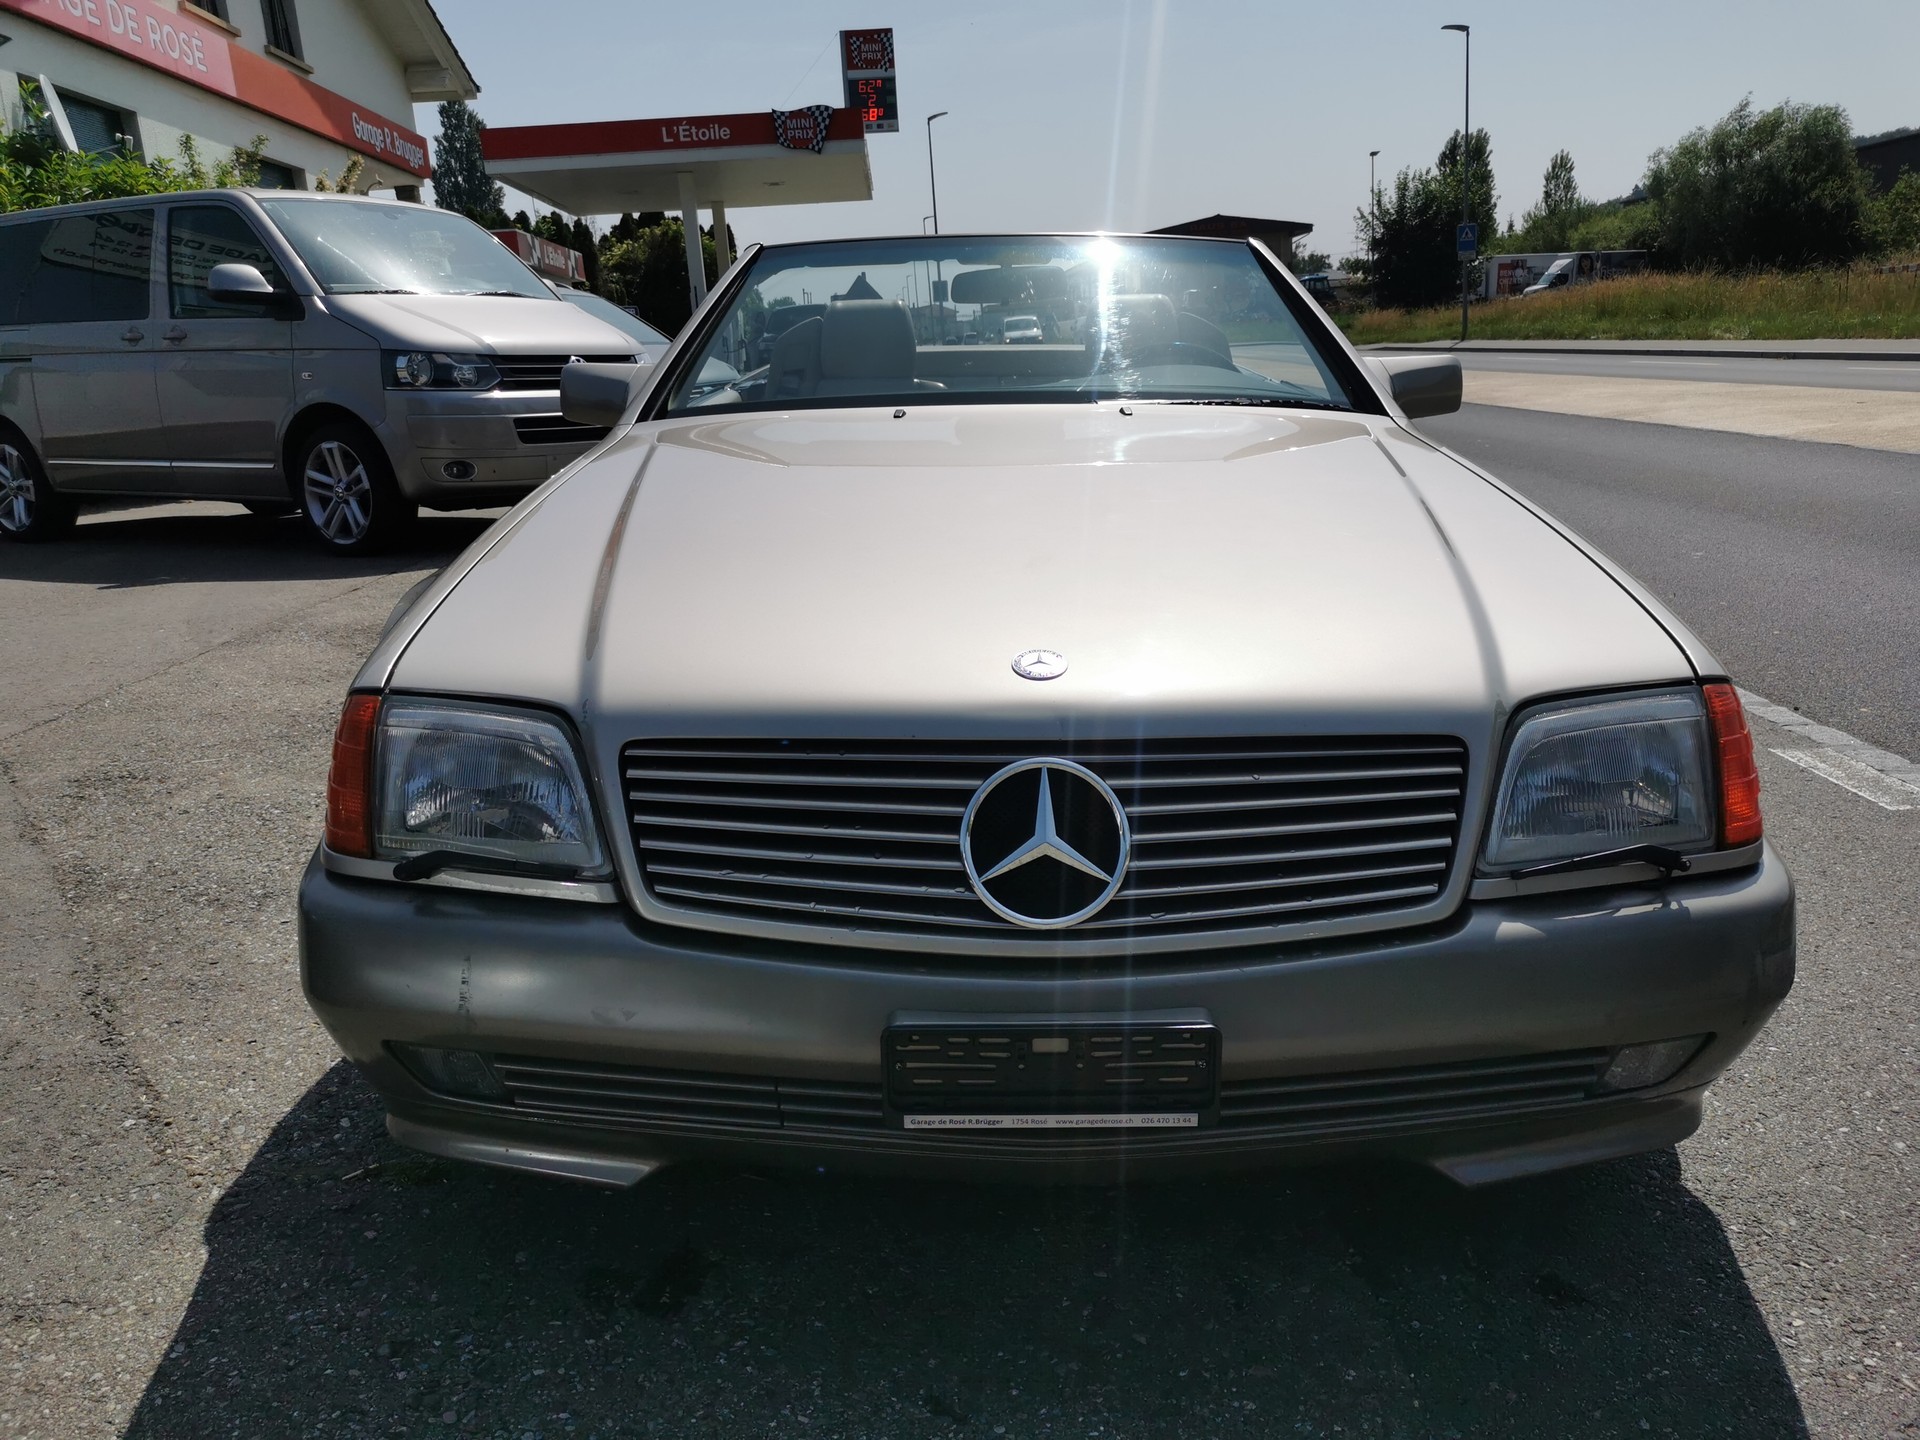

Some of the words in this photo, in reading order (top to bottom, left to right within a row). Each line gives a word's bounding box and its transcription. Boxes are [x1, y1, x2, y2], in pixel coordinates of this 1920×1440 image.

[106, 0, 143, 43] DE
[145, 15, 208, 72] ROSÉ
[861, 43, 882, 52] MINI
[861, 52, 882, 60] PRIX
[786, 118, 814, 130] MINI
[352, 111, 385, 153] Garage
[661, 121, 731, 143] L'Étoile
[787, 129, 815, 140] PRIX
[910, 1118, 936, 1126] Garage
[949, 1117, 966, 1125] Rosé
[1030, 1117, 1048, 1125] Rosé
[1055, 1117, 1134, 1126] www.garagederose.ch
